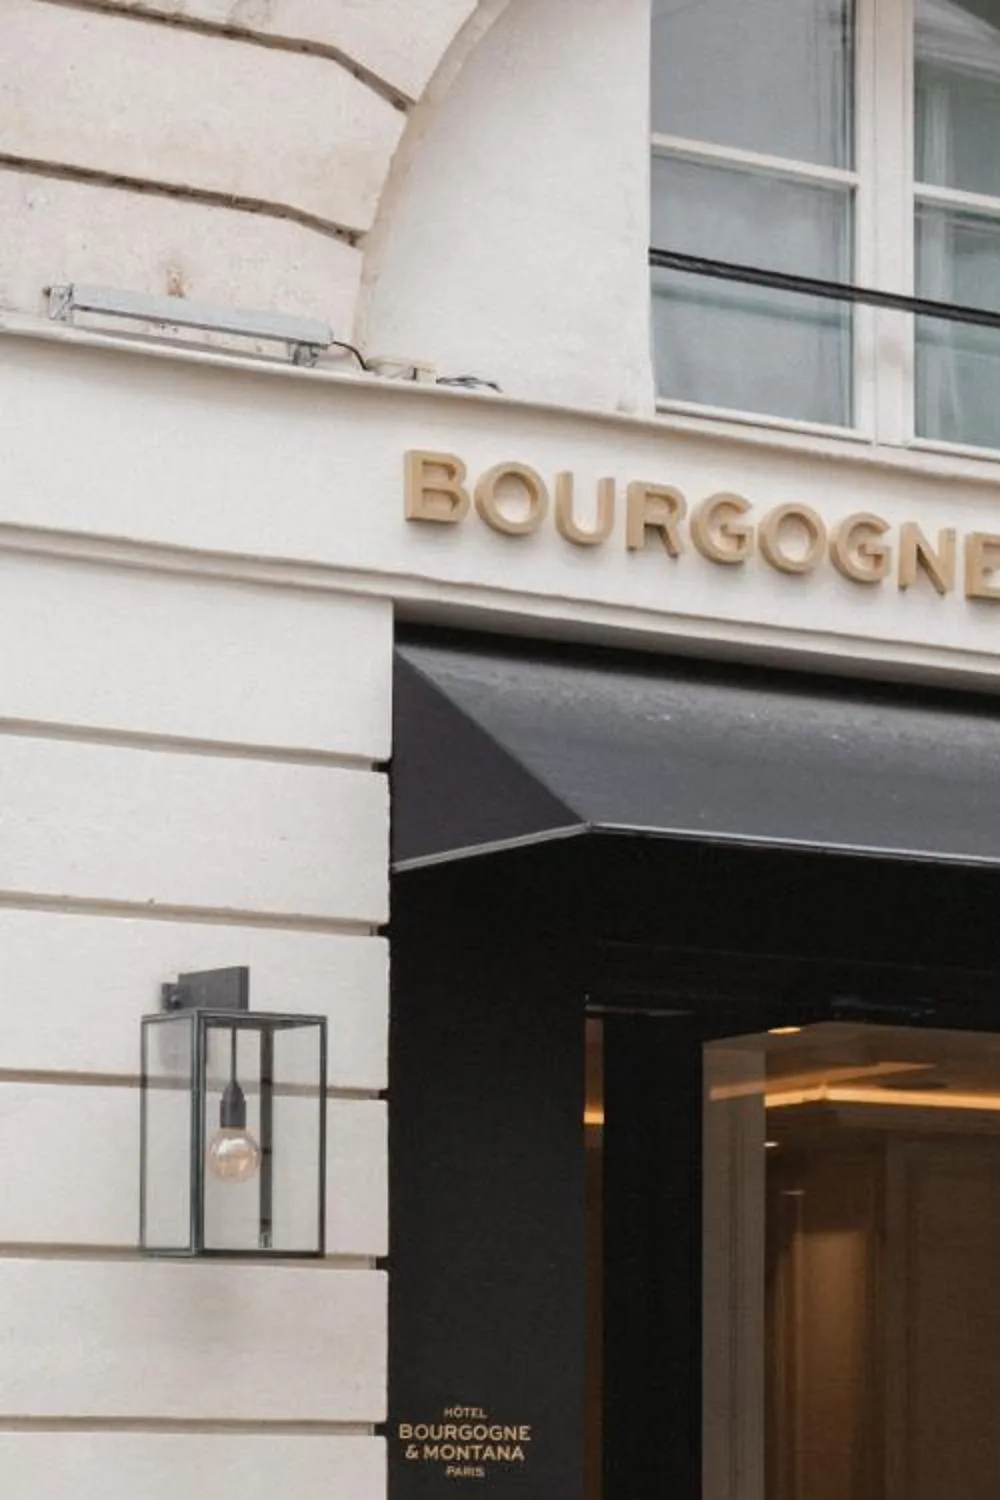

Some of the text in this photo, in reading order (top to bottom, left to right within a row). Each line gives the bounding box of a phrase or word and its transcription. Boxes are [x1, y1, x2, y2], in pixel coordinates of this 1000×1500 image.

[443, 1404, 487, 1419] HÔTEL
[399, 1423, 531, 1441] BOURGOGNE
[405, 1444, 525, 1461] & MONTANA
[446, 1465, 485, 1477] PARIS
